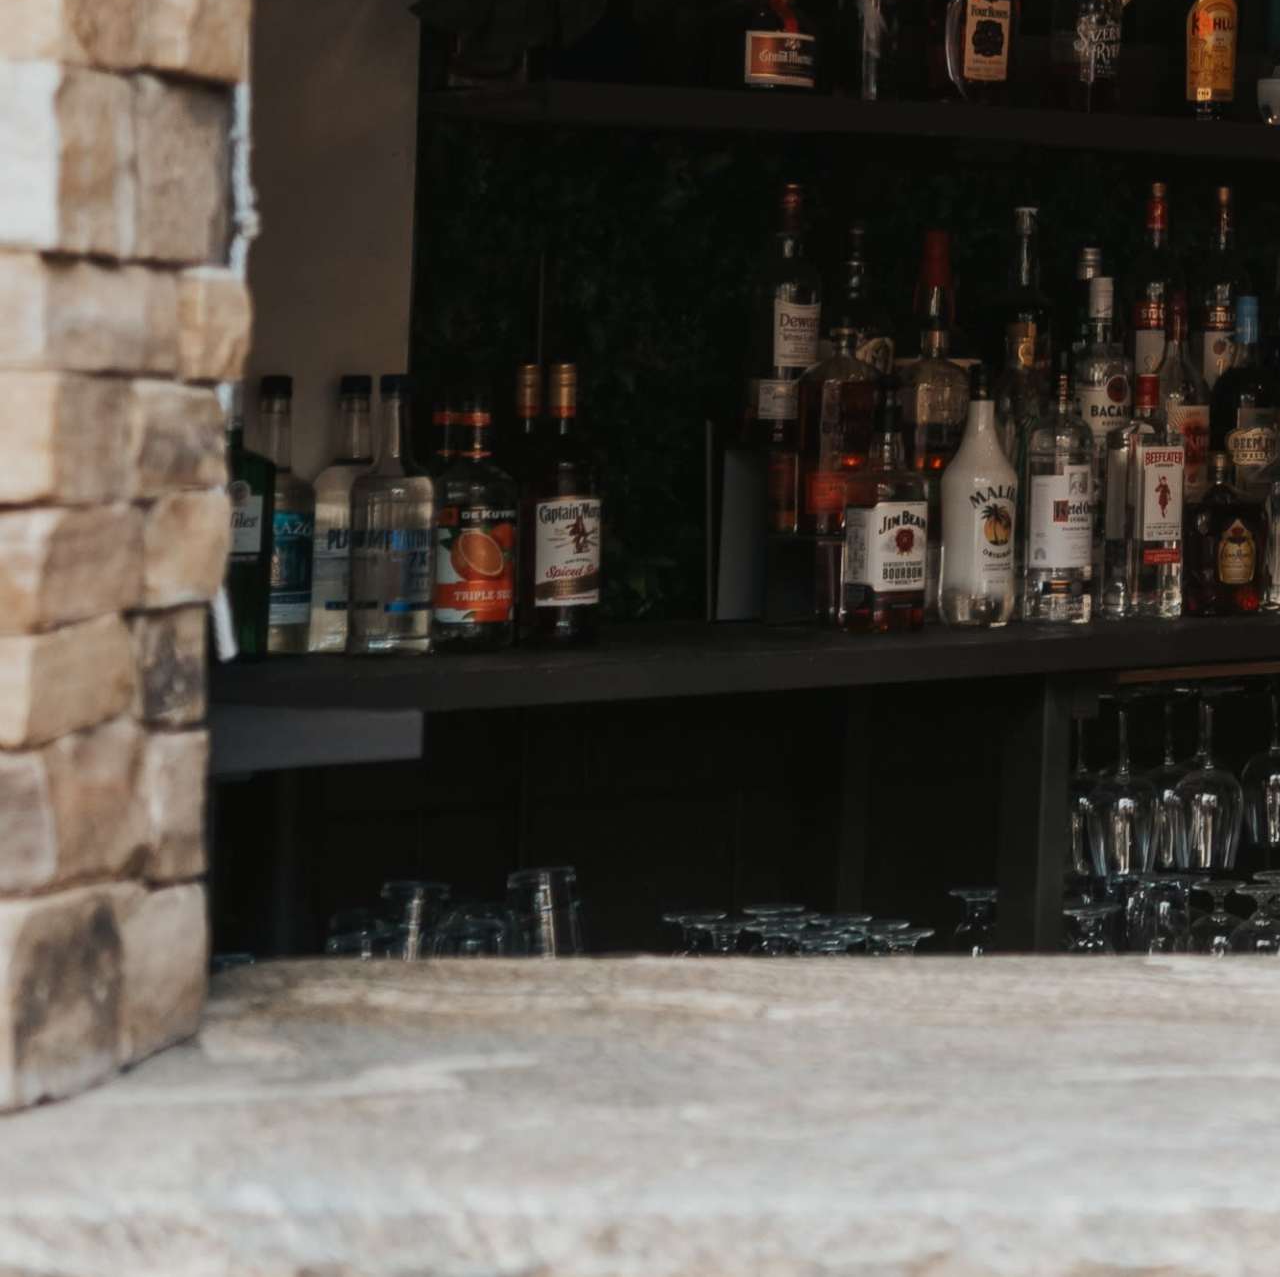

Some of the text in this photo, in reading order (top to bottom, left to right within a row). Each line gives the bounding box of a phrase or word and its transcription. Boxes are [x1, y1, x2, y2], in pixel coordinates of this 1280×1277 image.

[1145, 450, 1184, 465] BEEFEATER
[539, 504, 577, 524] Captain
[878, 515, 900, 535] JIM
[546, 565, 584, 579] Spiced
[882, 567, 923, 579] BOURBON
[453, 590, 493, 602] TRIPLE
